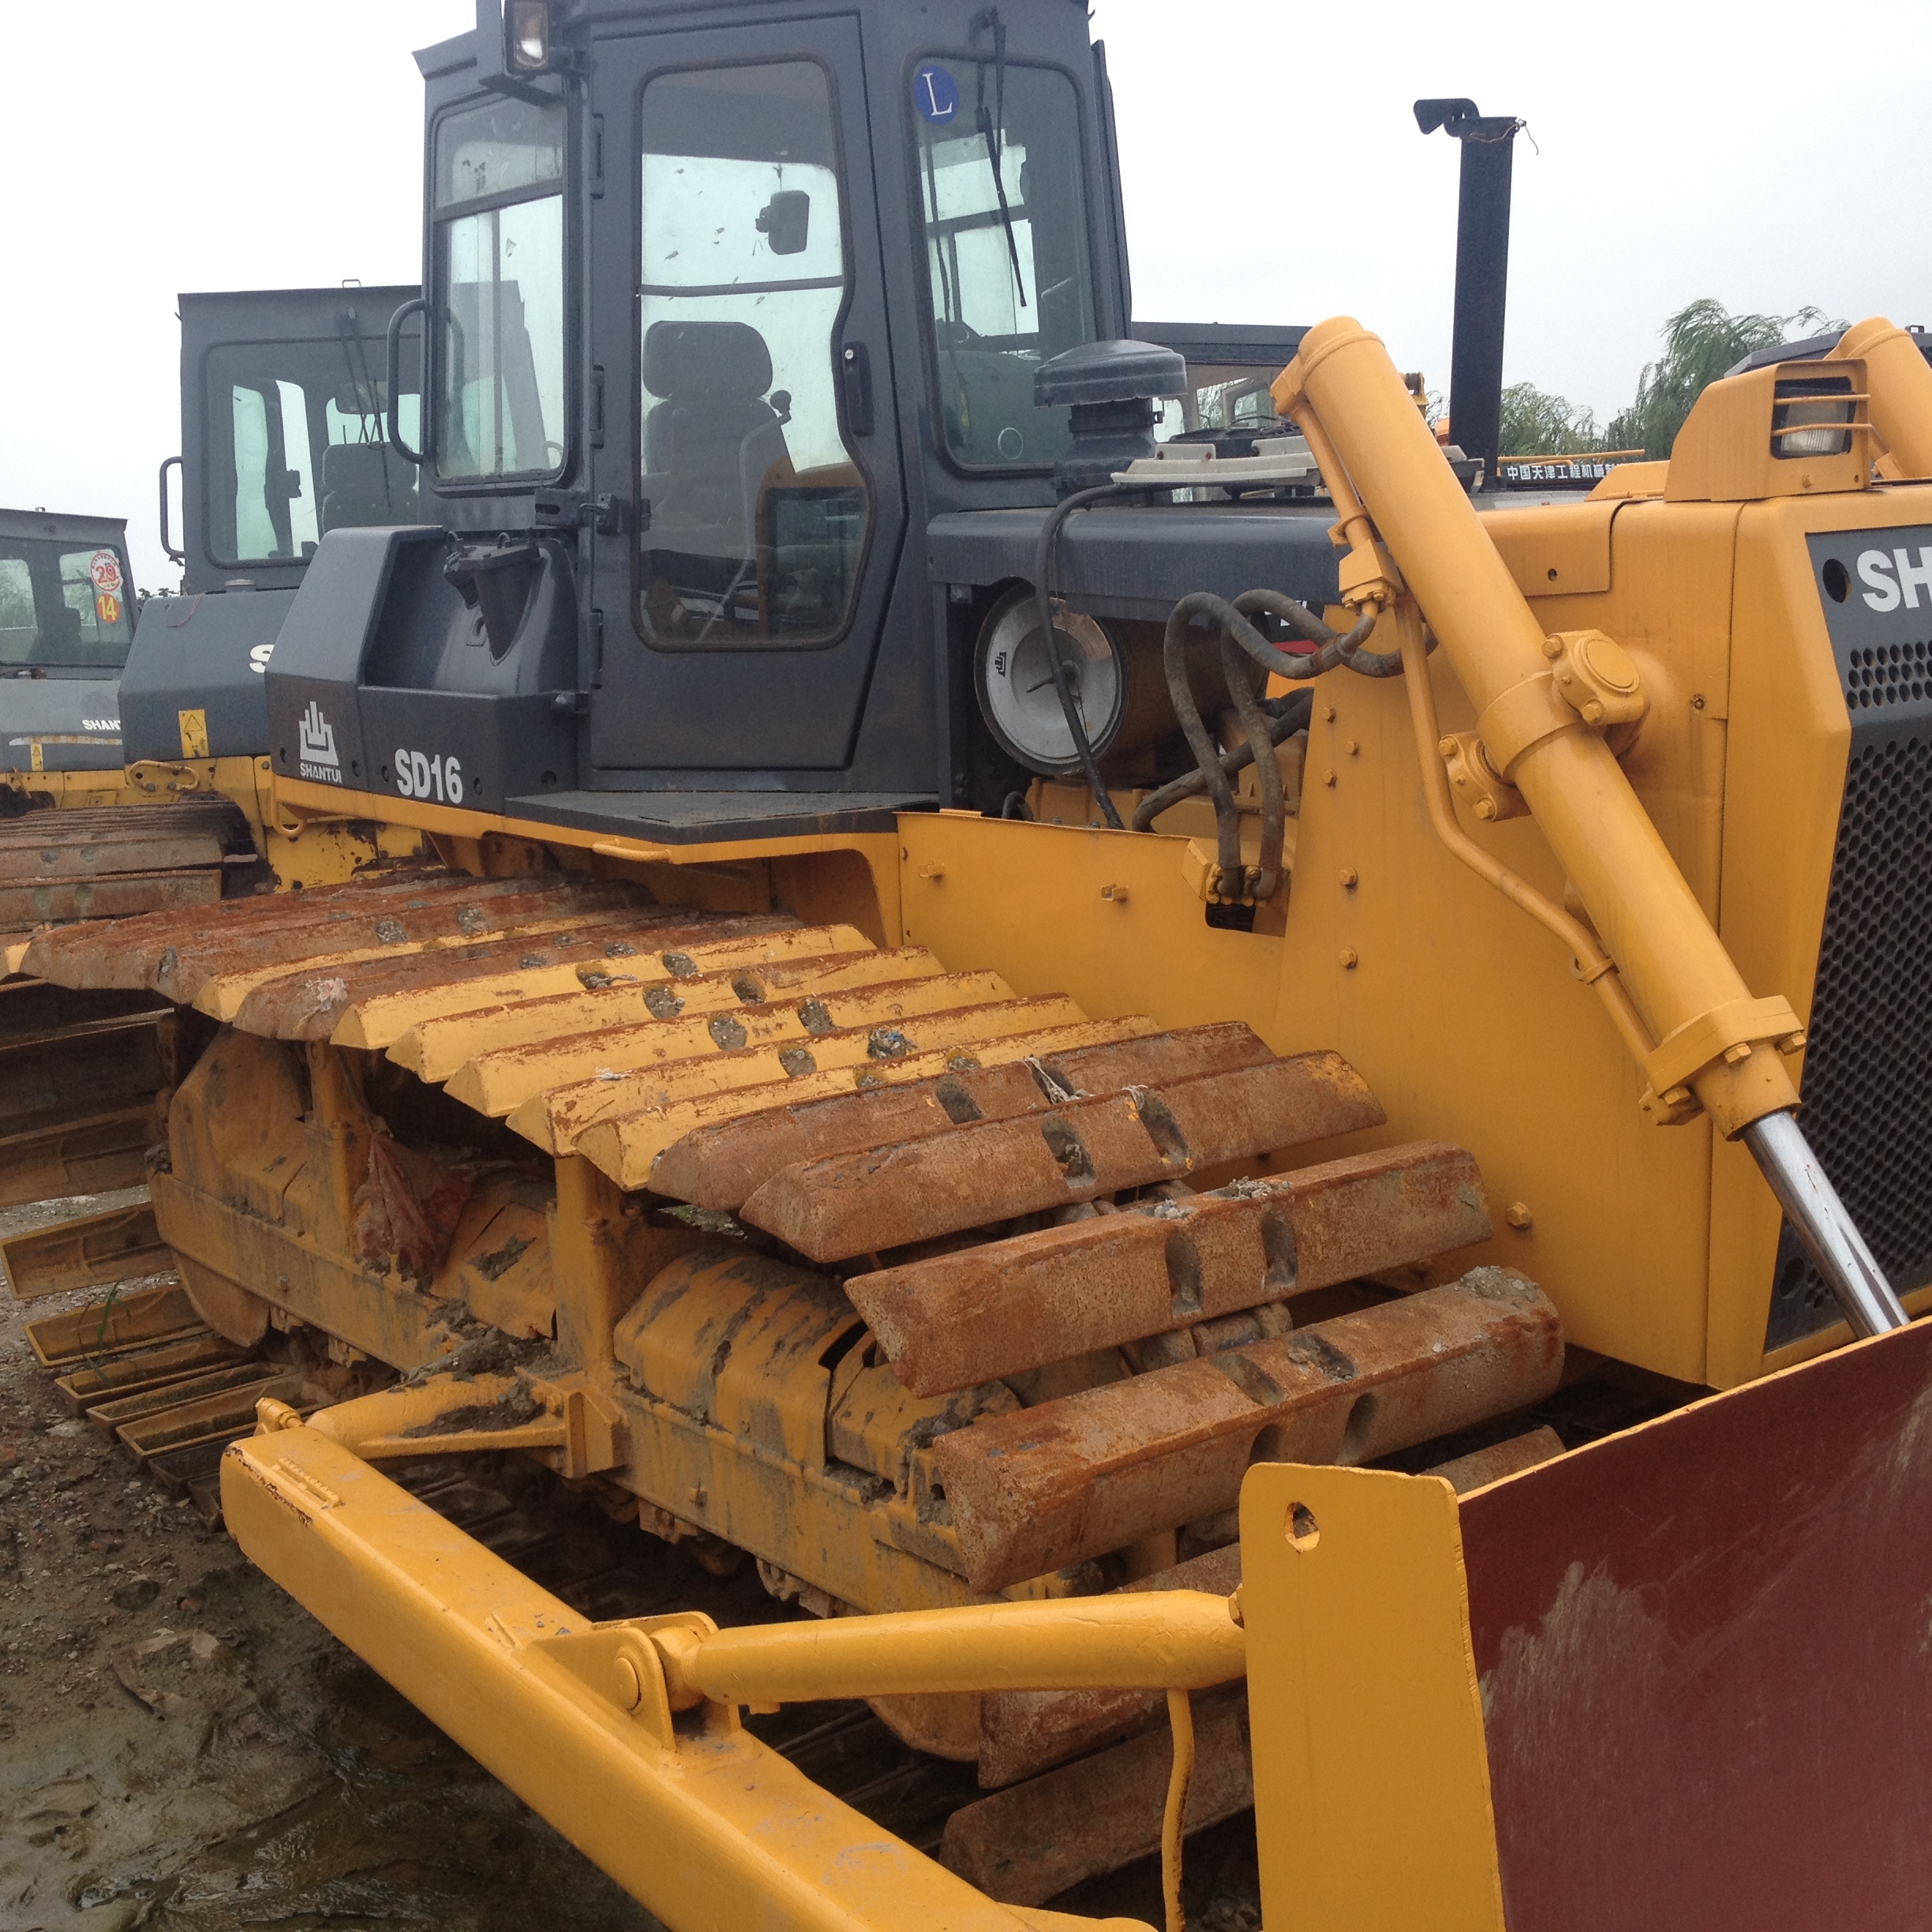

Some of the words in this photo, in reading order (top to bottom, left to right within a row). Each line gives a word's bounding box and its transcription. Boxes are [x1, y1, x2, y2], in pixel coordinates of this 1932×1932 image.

[922, 72, 953, 116] L
[95, 563, 118, 584] 29
[98, 595, 117, 621] 14
[300, 762, 343, 784] SHANTUI
[395, 748, 463, 804] SD16
